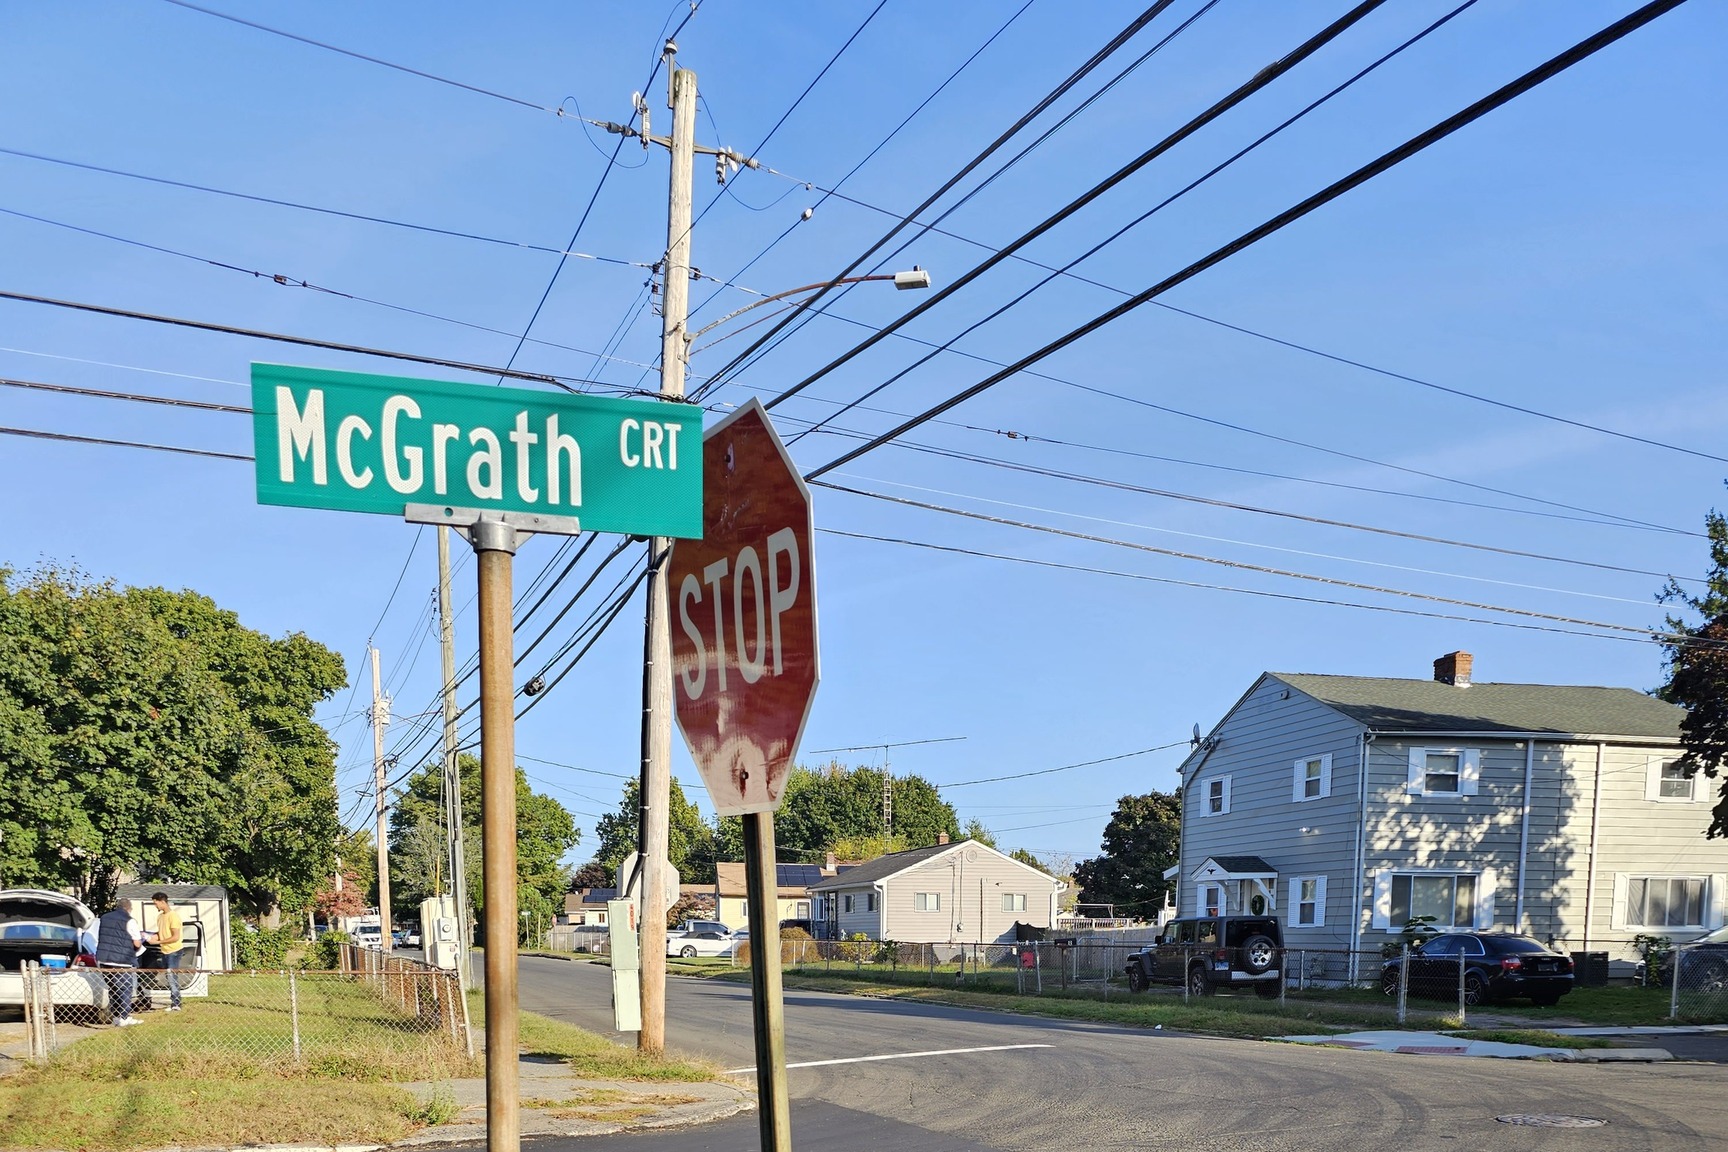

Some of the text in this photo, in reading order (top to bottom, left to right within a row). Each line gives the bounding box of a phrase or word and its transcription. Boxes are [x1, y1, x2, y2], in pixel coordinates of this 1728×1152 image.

[276, 386, 682, 506] McGrath CRT
[679, 526, 800, 700] STOP
